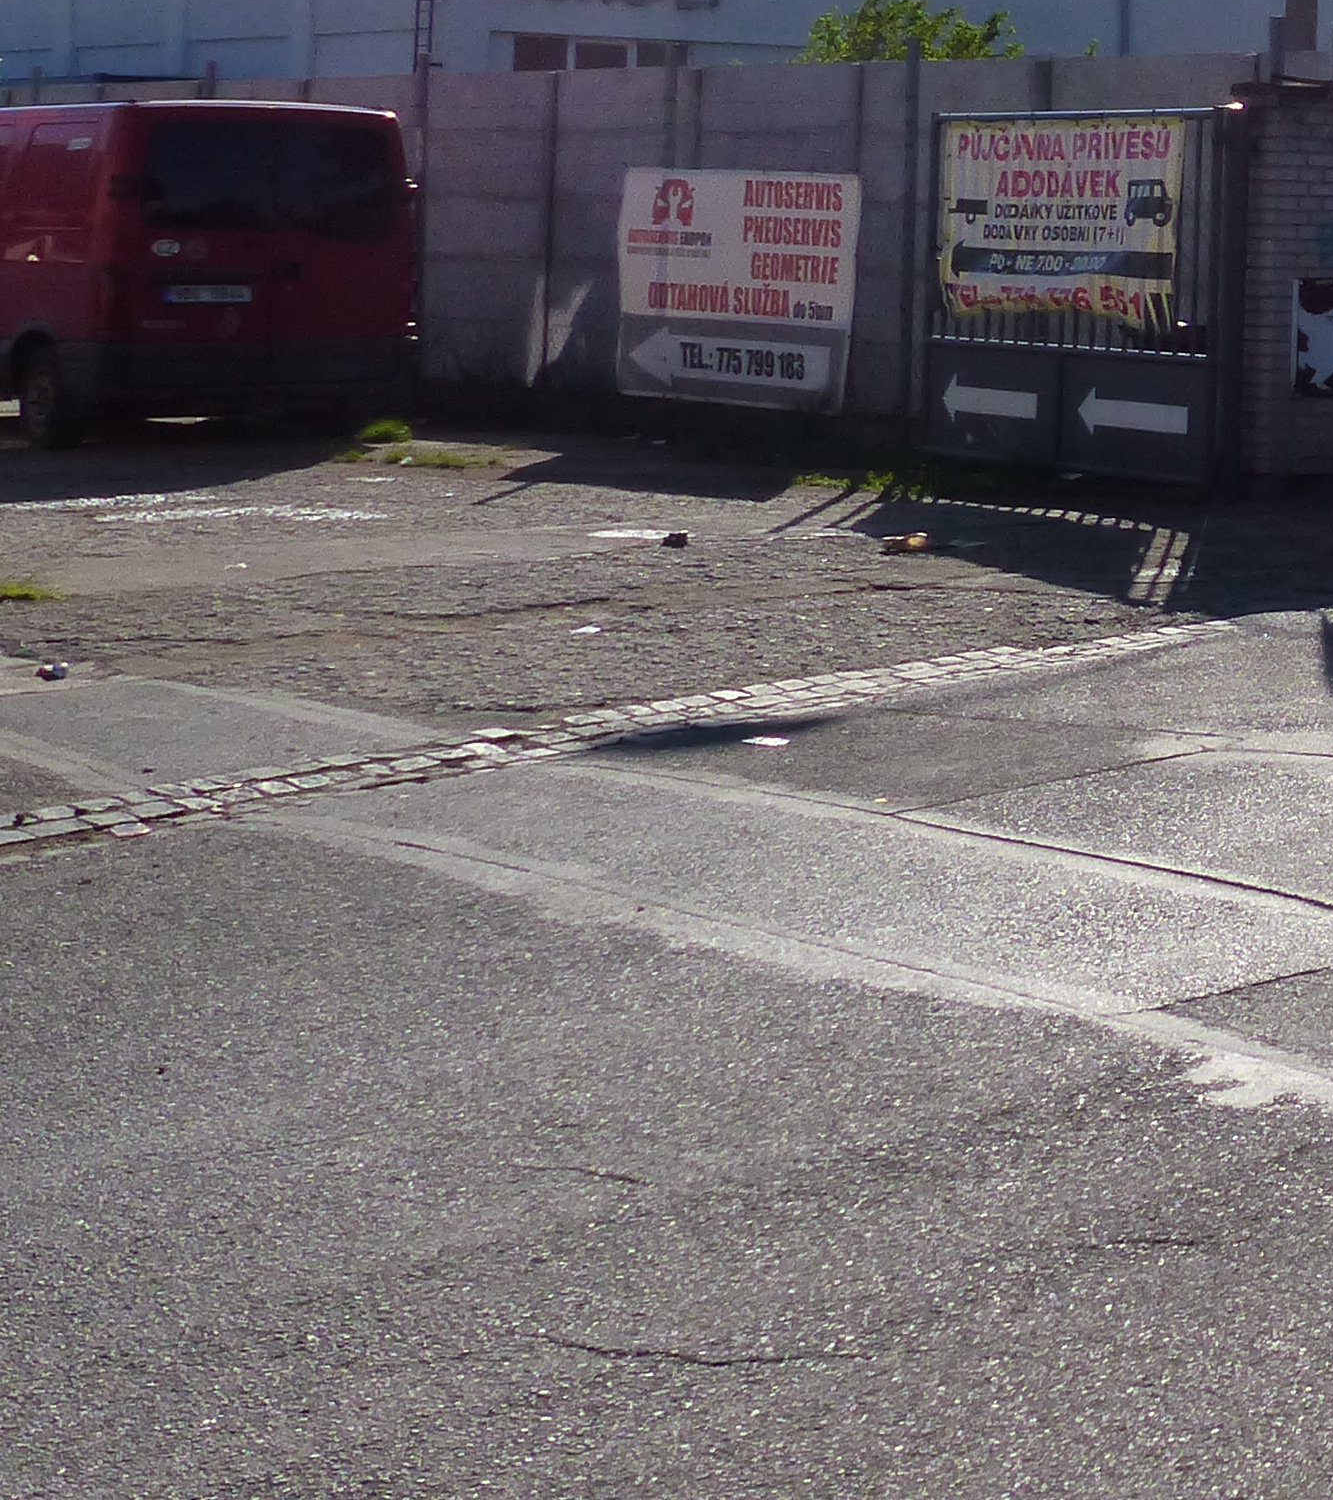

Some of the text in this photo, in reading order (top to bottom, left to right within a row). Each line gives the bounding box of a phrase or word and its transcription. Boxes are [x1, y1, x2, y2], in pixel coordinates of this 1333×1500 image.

[958, 127, 1065, 161] PŮJČVNA
[744, 180, 843, 211] AUTOSERVIS
[743, 216, 841, 248] PNEUSERVIS
[751, 252, 839, 284] GEOMETRIE
[648, 281, 729, 314] ODTAHOVÁ
[733, 283, 790, 318] SLUŽBA
[716, 347, 742, 375] 775
[746, 349, 774, 377] 799
[778, 352, 805, 380] 183
